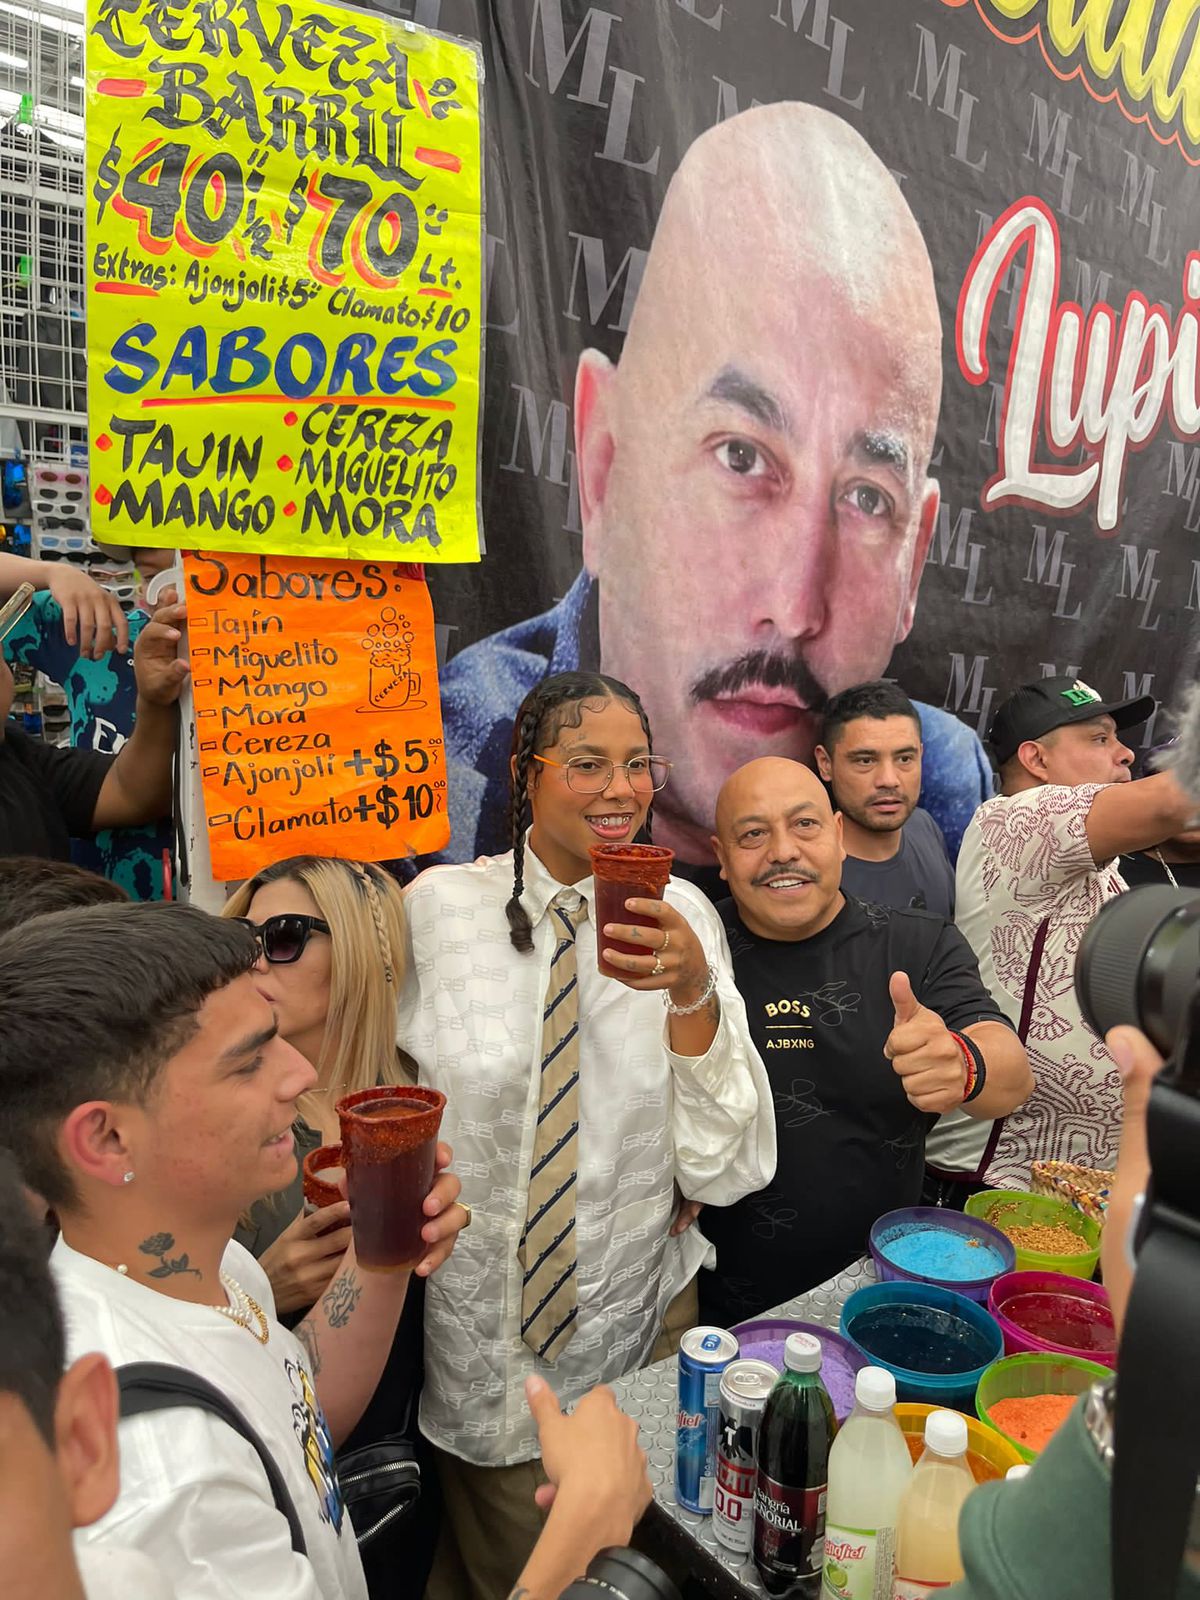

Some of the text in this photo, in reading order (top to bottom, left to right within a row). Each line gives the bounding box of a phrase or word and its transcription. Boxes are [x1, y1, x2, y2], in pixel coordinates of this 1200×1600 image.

[908, 23, 987, 172] ML
[1022, 92, 1088, 224] ML
[1116, 150, 1170, 267] ML
[93, 243, 177, 291] Extras:
[419, 253, 462, 290] Lt.
[104, 322, 458, 399] SABORES
[109, 414, 264, 483] TAJIN
[301, 403, 453, 458] CEREZA
[295, 447, 457, 502] MIGUELITO
[108, 479, 276, 535] MANGO
[300, 489, 443, 548] MORA
[1023, 524, 1081, 619] ML
[1116, 543, 1161, 631] ML
[212, 638, 339, 682] Miguelito
[217, 674, 328, 707] Mango
[221, 702, 307, 729] Mora
[221, 730, 332, 756] Cereza
[764, 999, 811, 1019] BOSS
[766, 1038, 815, 1050] AJBXNG
